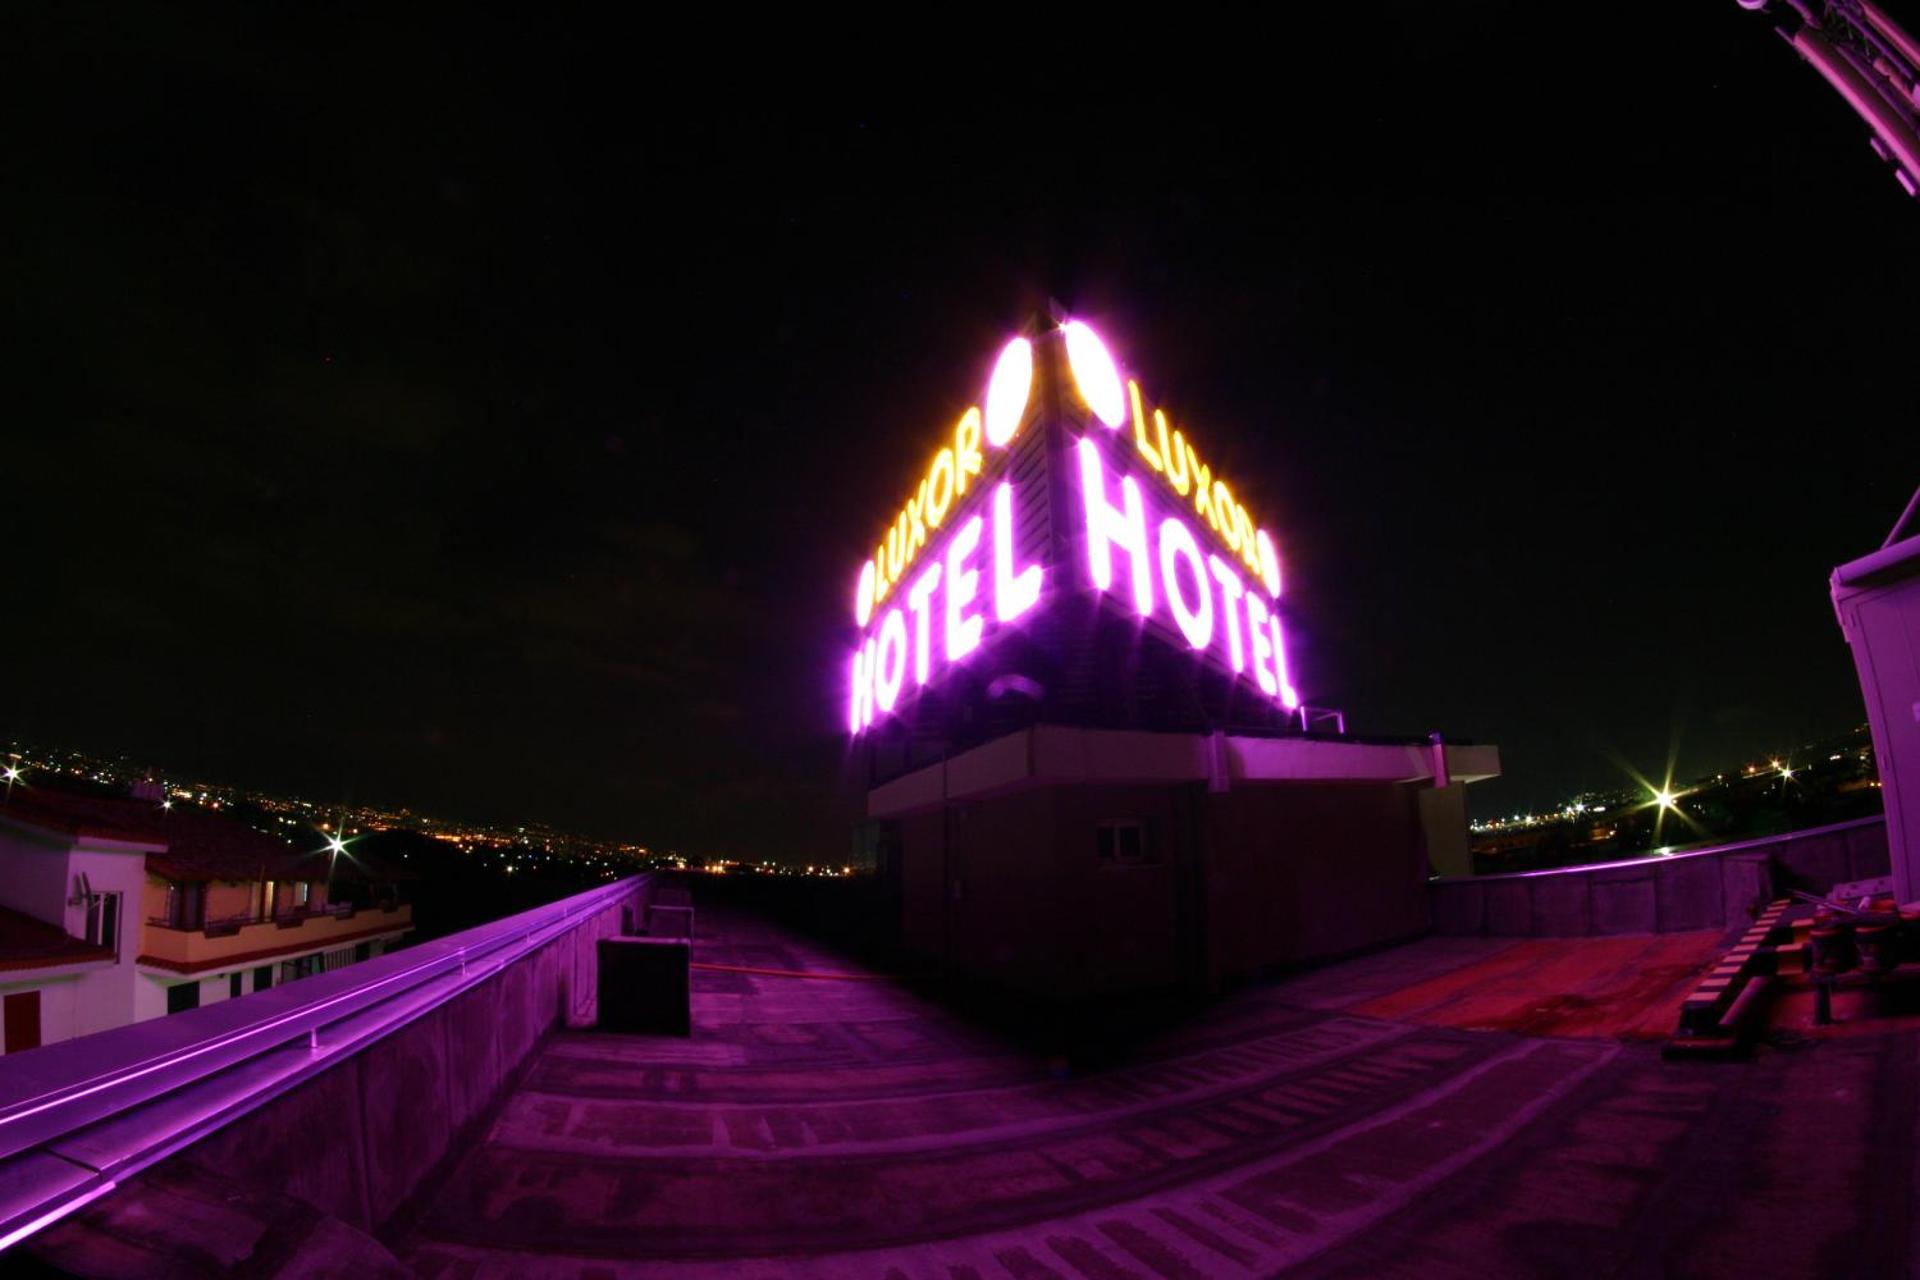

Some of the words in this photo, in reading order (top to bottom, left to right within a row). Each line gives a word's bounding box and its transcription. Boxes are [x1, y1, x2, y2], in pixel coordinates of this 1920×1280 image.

[874, 406, 983, 603] LUXOR
[1078, 437, 1298, 709] HOTEL
[1128, 379, 1263, 577] LUXOR
[850, 481, 1043, 735] HOTEL
